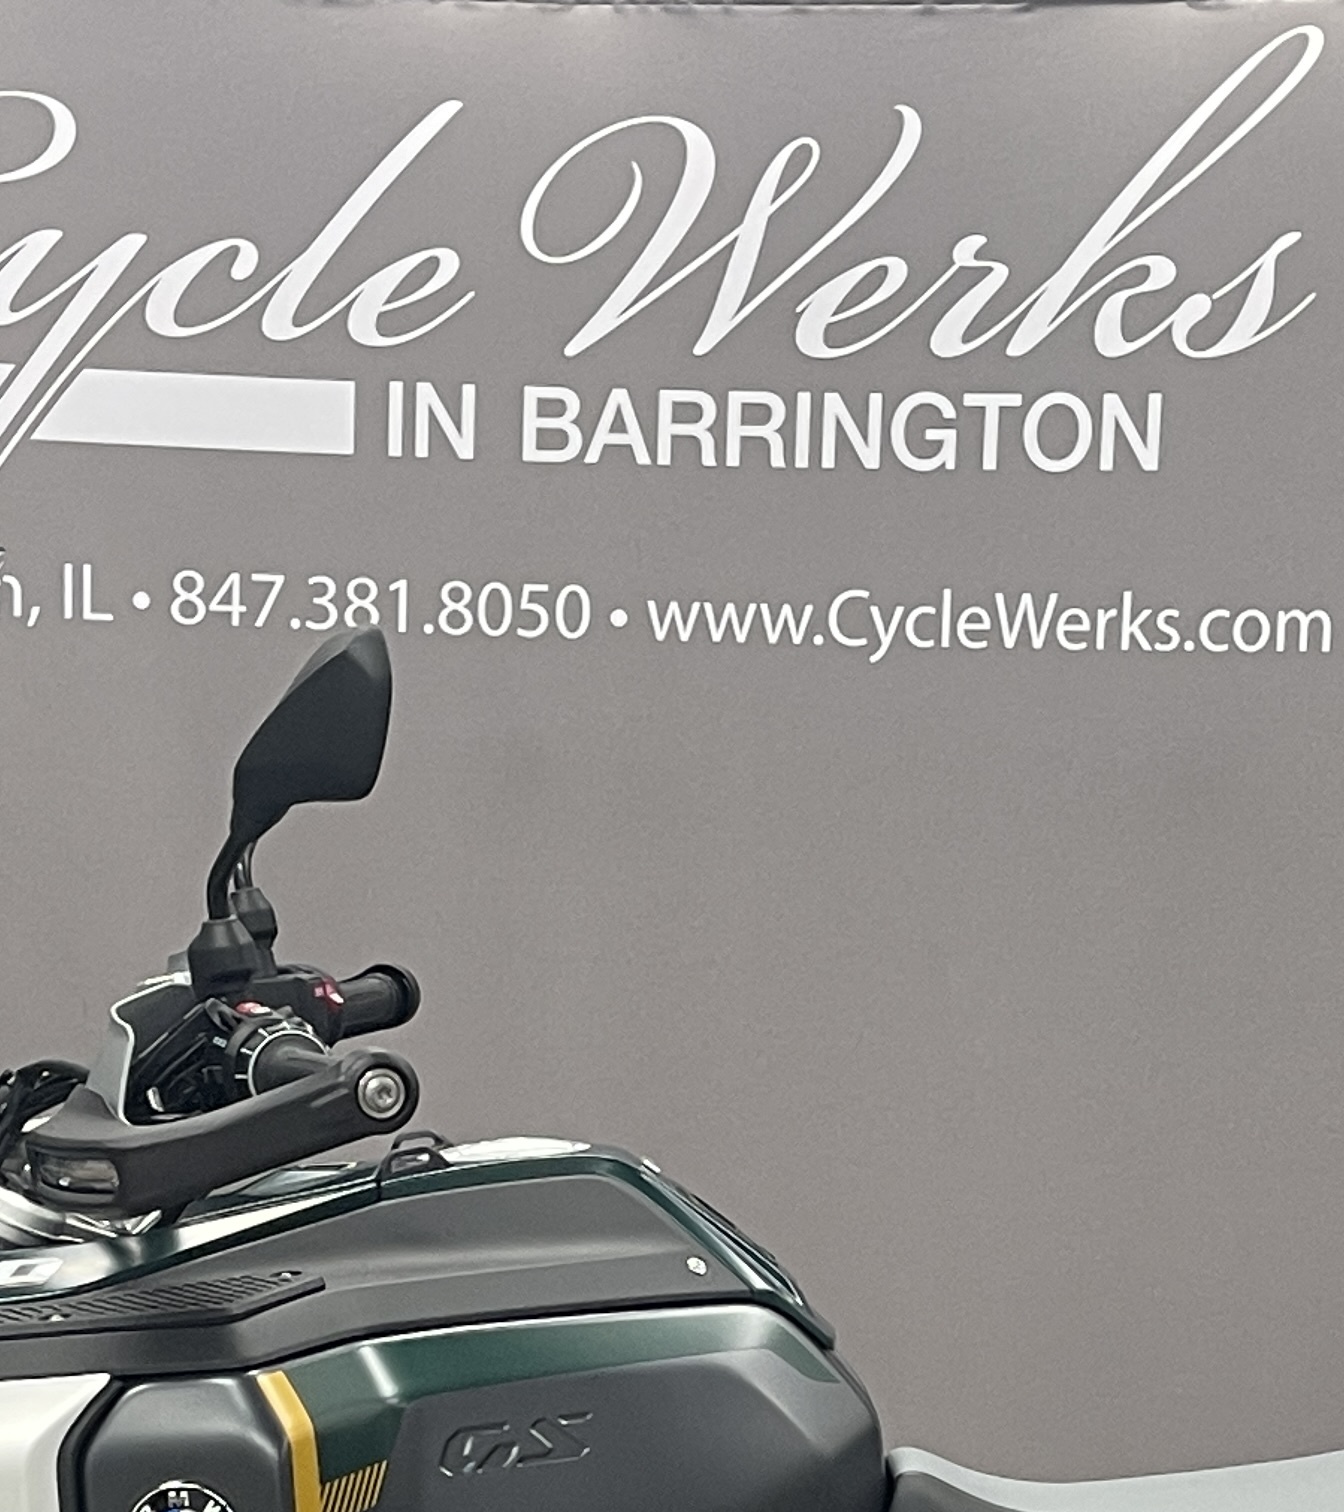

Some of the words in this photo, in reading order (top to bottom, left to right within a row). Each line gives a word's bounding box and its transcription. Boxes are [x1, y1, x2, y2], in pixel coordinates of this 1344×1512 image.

[517, 24, 1325, 358] Werks
[388, 380, 476, 460] IN
[521, 385, 1163, 473] BARRINGTON
[64, 563, 115, 622] IL
[170, 570, 590, 640] 847.381.8050
[647, 588, 1332, 664] www.CycleWerks.com
[438, 1410, 594, 1478] GS
